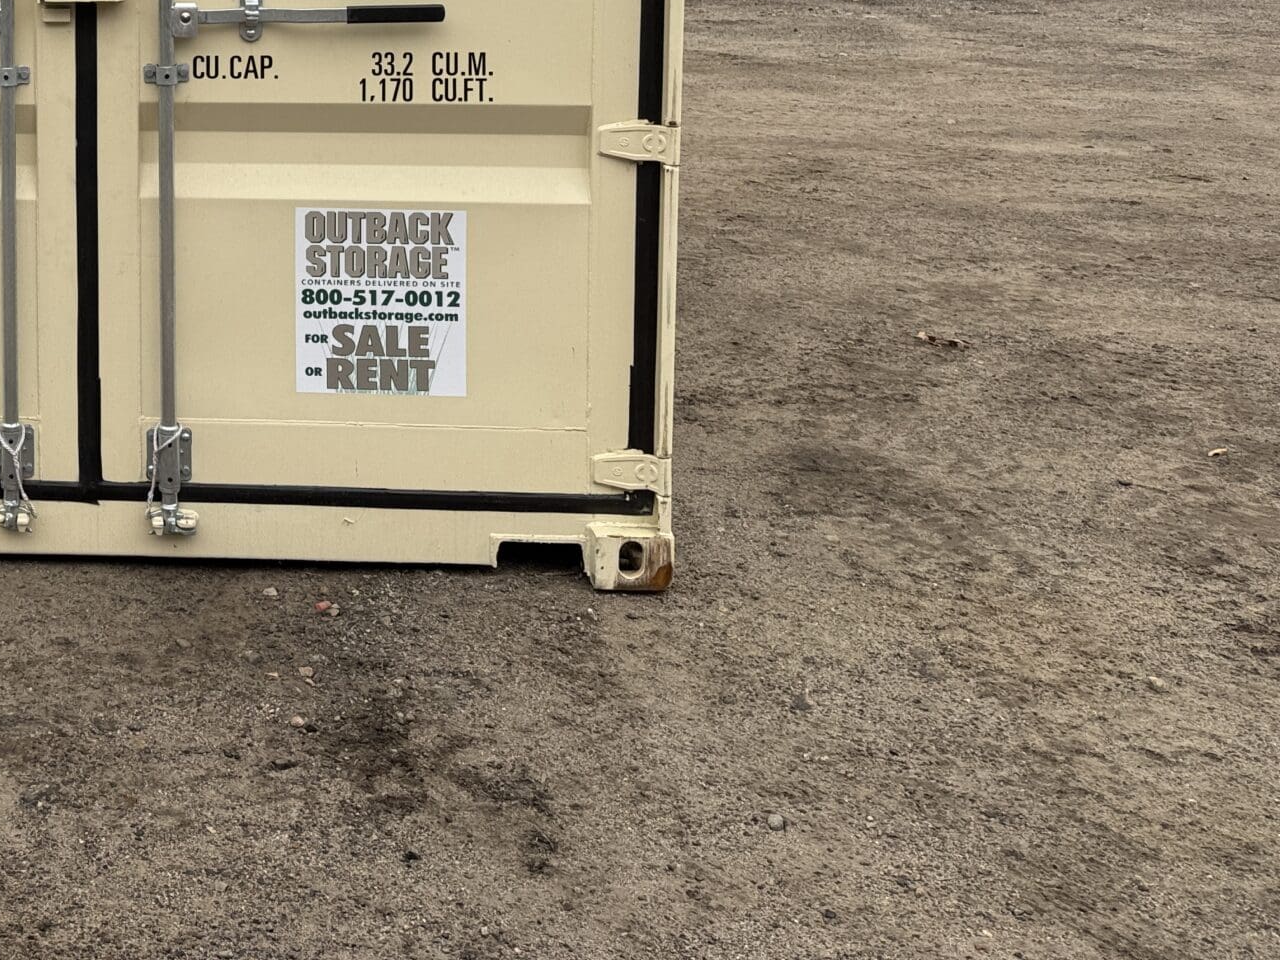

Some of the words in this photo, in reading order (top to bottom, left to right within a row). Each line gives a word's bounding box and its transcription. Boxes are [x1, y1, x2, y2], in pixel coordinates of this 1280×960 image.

[193, 55, 278, 79] CU.CAP.
[372, 52, 413, 76] 33.2
[432, 52, 493, 76] CU.M.
[360, 78, 413, 101] 1,170
[432, 78, 493, 101] CU.FT.
[305, 211, 454, 245] OUTBACK
[305, 245, 449, 279] STORAGE
[301, 289, 460, 307] 800-517-0012
[303, 308, 459, 323] outbackstorage.com
[305, 334, 328, 343] FOR
[332, 324, 430, 357] SALE
[305, 367, 322, 376] OR
[326, 358, 435, 391] RENT
